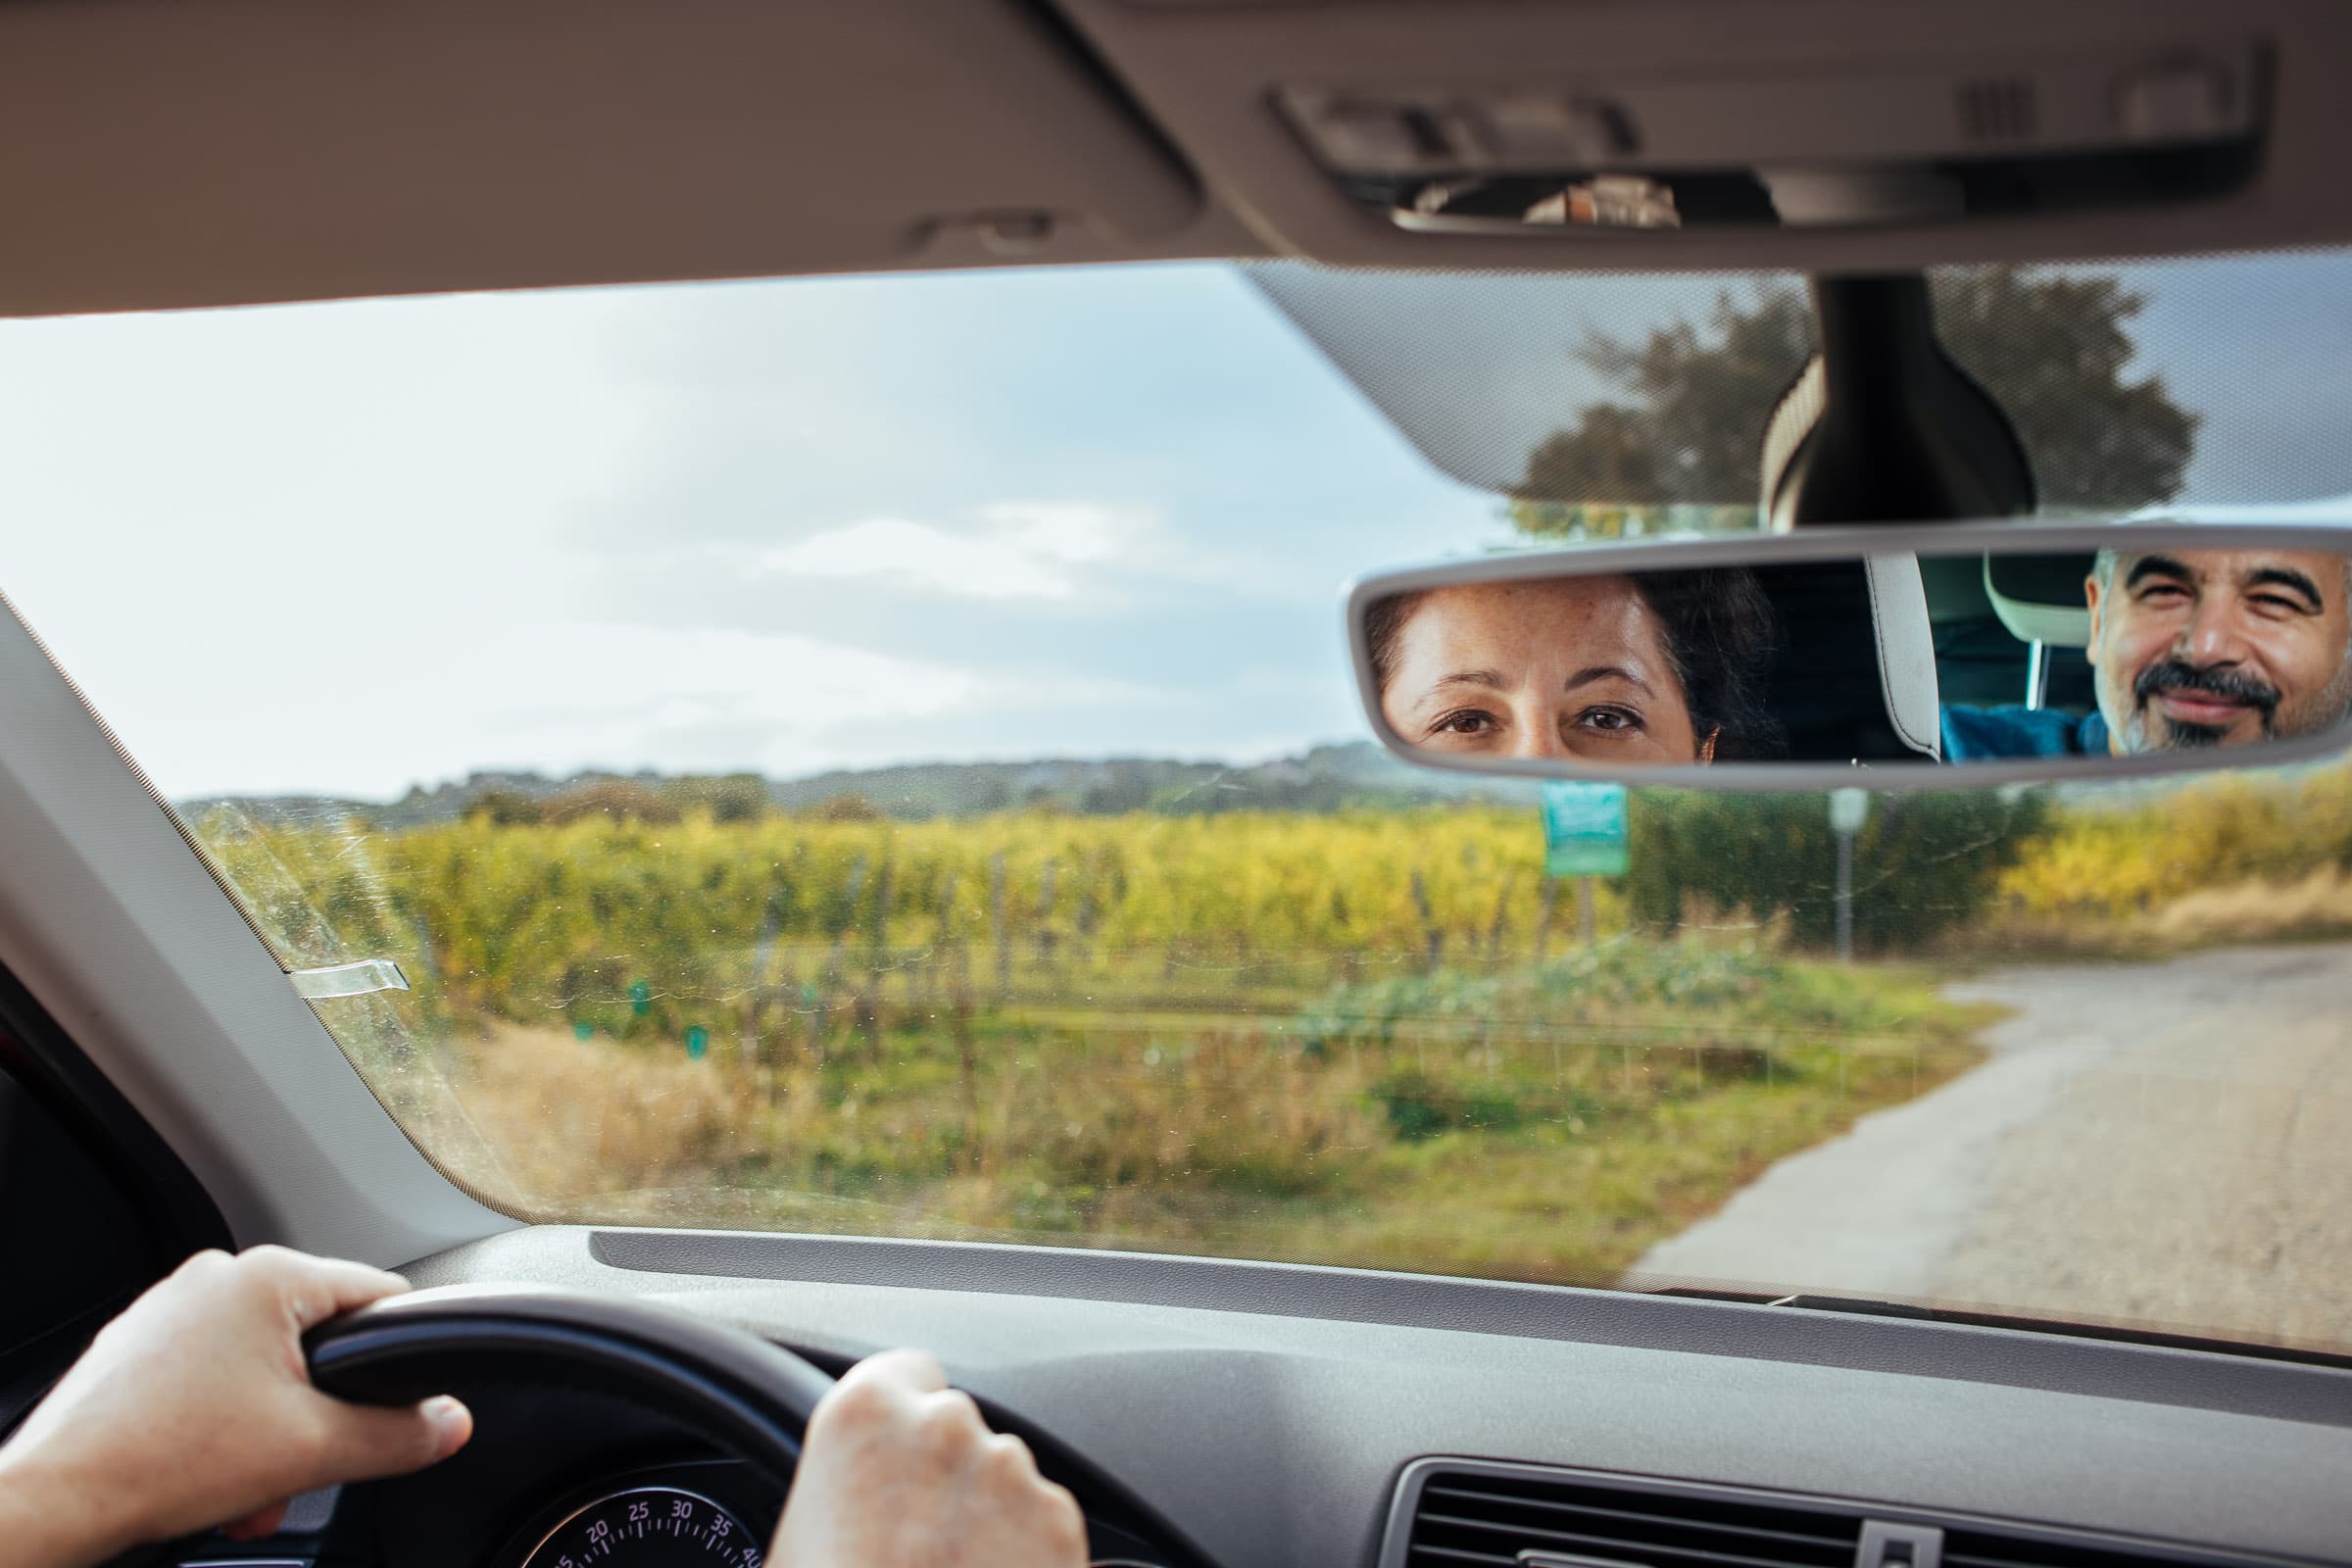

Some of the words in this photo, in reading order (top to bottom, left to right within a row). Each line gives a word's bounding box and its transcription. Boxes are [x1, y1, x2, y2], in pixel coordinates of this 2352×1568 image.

[628, 1501, 650, 1521] 25
[672, 1500, 693, 1519] 30
[586, 1520, 609, 1544] 20
[710, 1514, 733, 1537] 35
